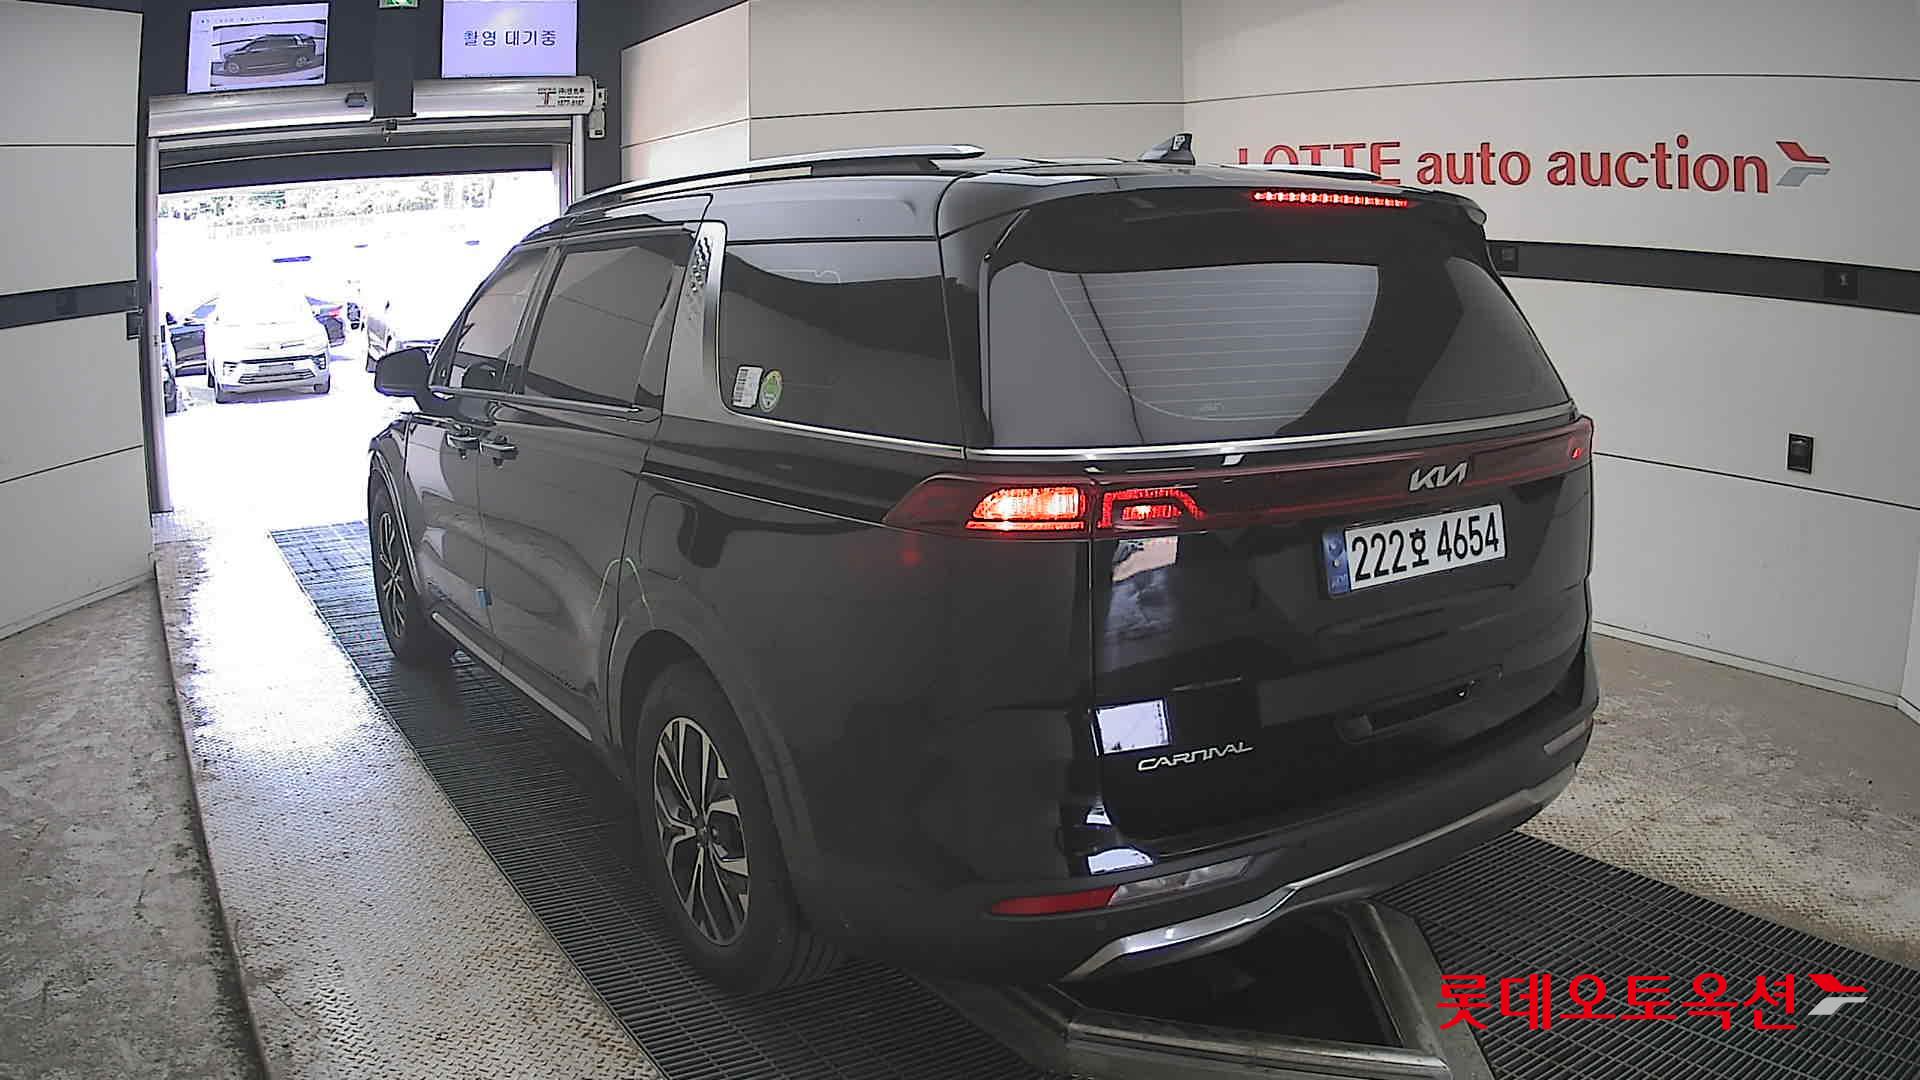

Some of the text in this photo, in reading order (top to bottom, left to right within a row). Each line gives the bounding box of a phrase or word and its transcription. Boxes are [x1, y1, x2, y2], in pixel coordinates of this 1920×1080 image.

[463, 30, 557, 47] 촬영 대기중
[1416, 141, 1532, 186] auto
[1546, 135, 1769, 194] auction
[1409, 461, 1468, 491] KIA
[1351, 511, 1499, 582] 222호 4654
[1138, 741, 1254, 771] CARNIVAL
